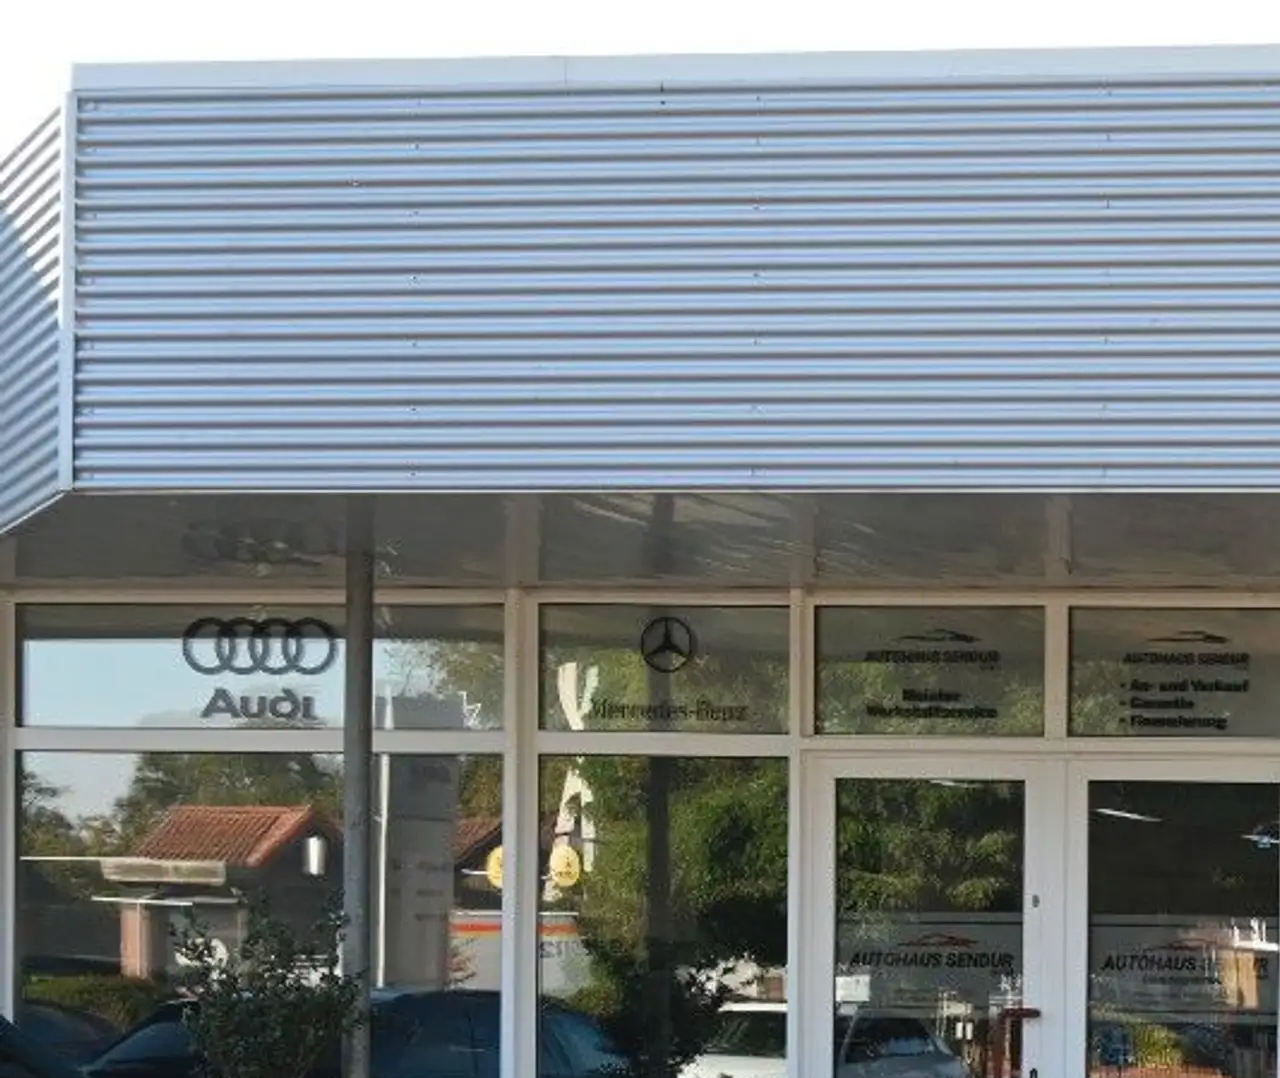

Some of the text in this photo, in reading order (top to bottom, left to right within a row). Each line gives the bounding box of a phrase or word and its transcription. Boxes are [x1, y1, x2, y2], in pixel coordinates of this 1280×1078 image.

[201, 687, 318, 719] Audi
[850, 952, 1015, 968] AUTOHAUS SENDUR
[1101, 954, 1197, 971] AUTOHAUS
